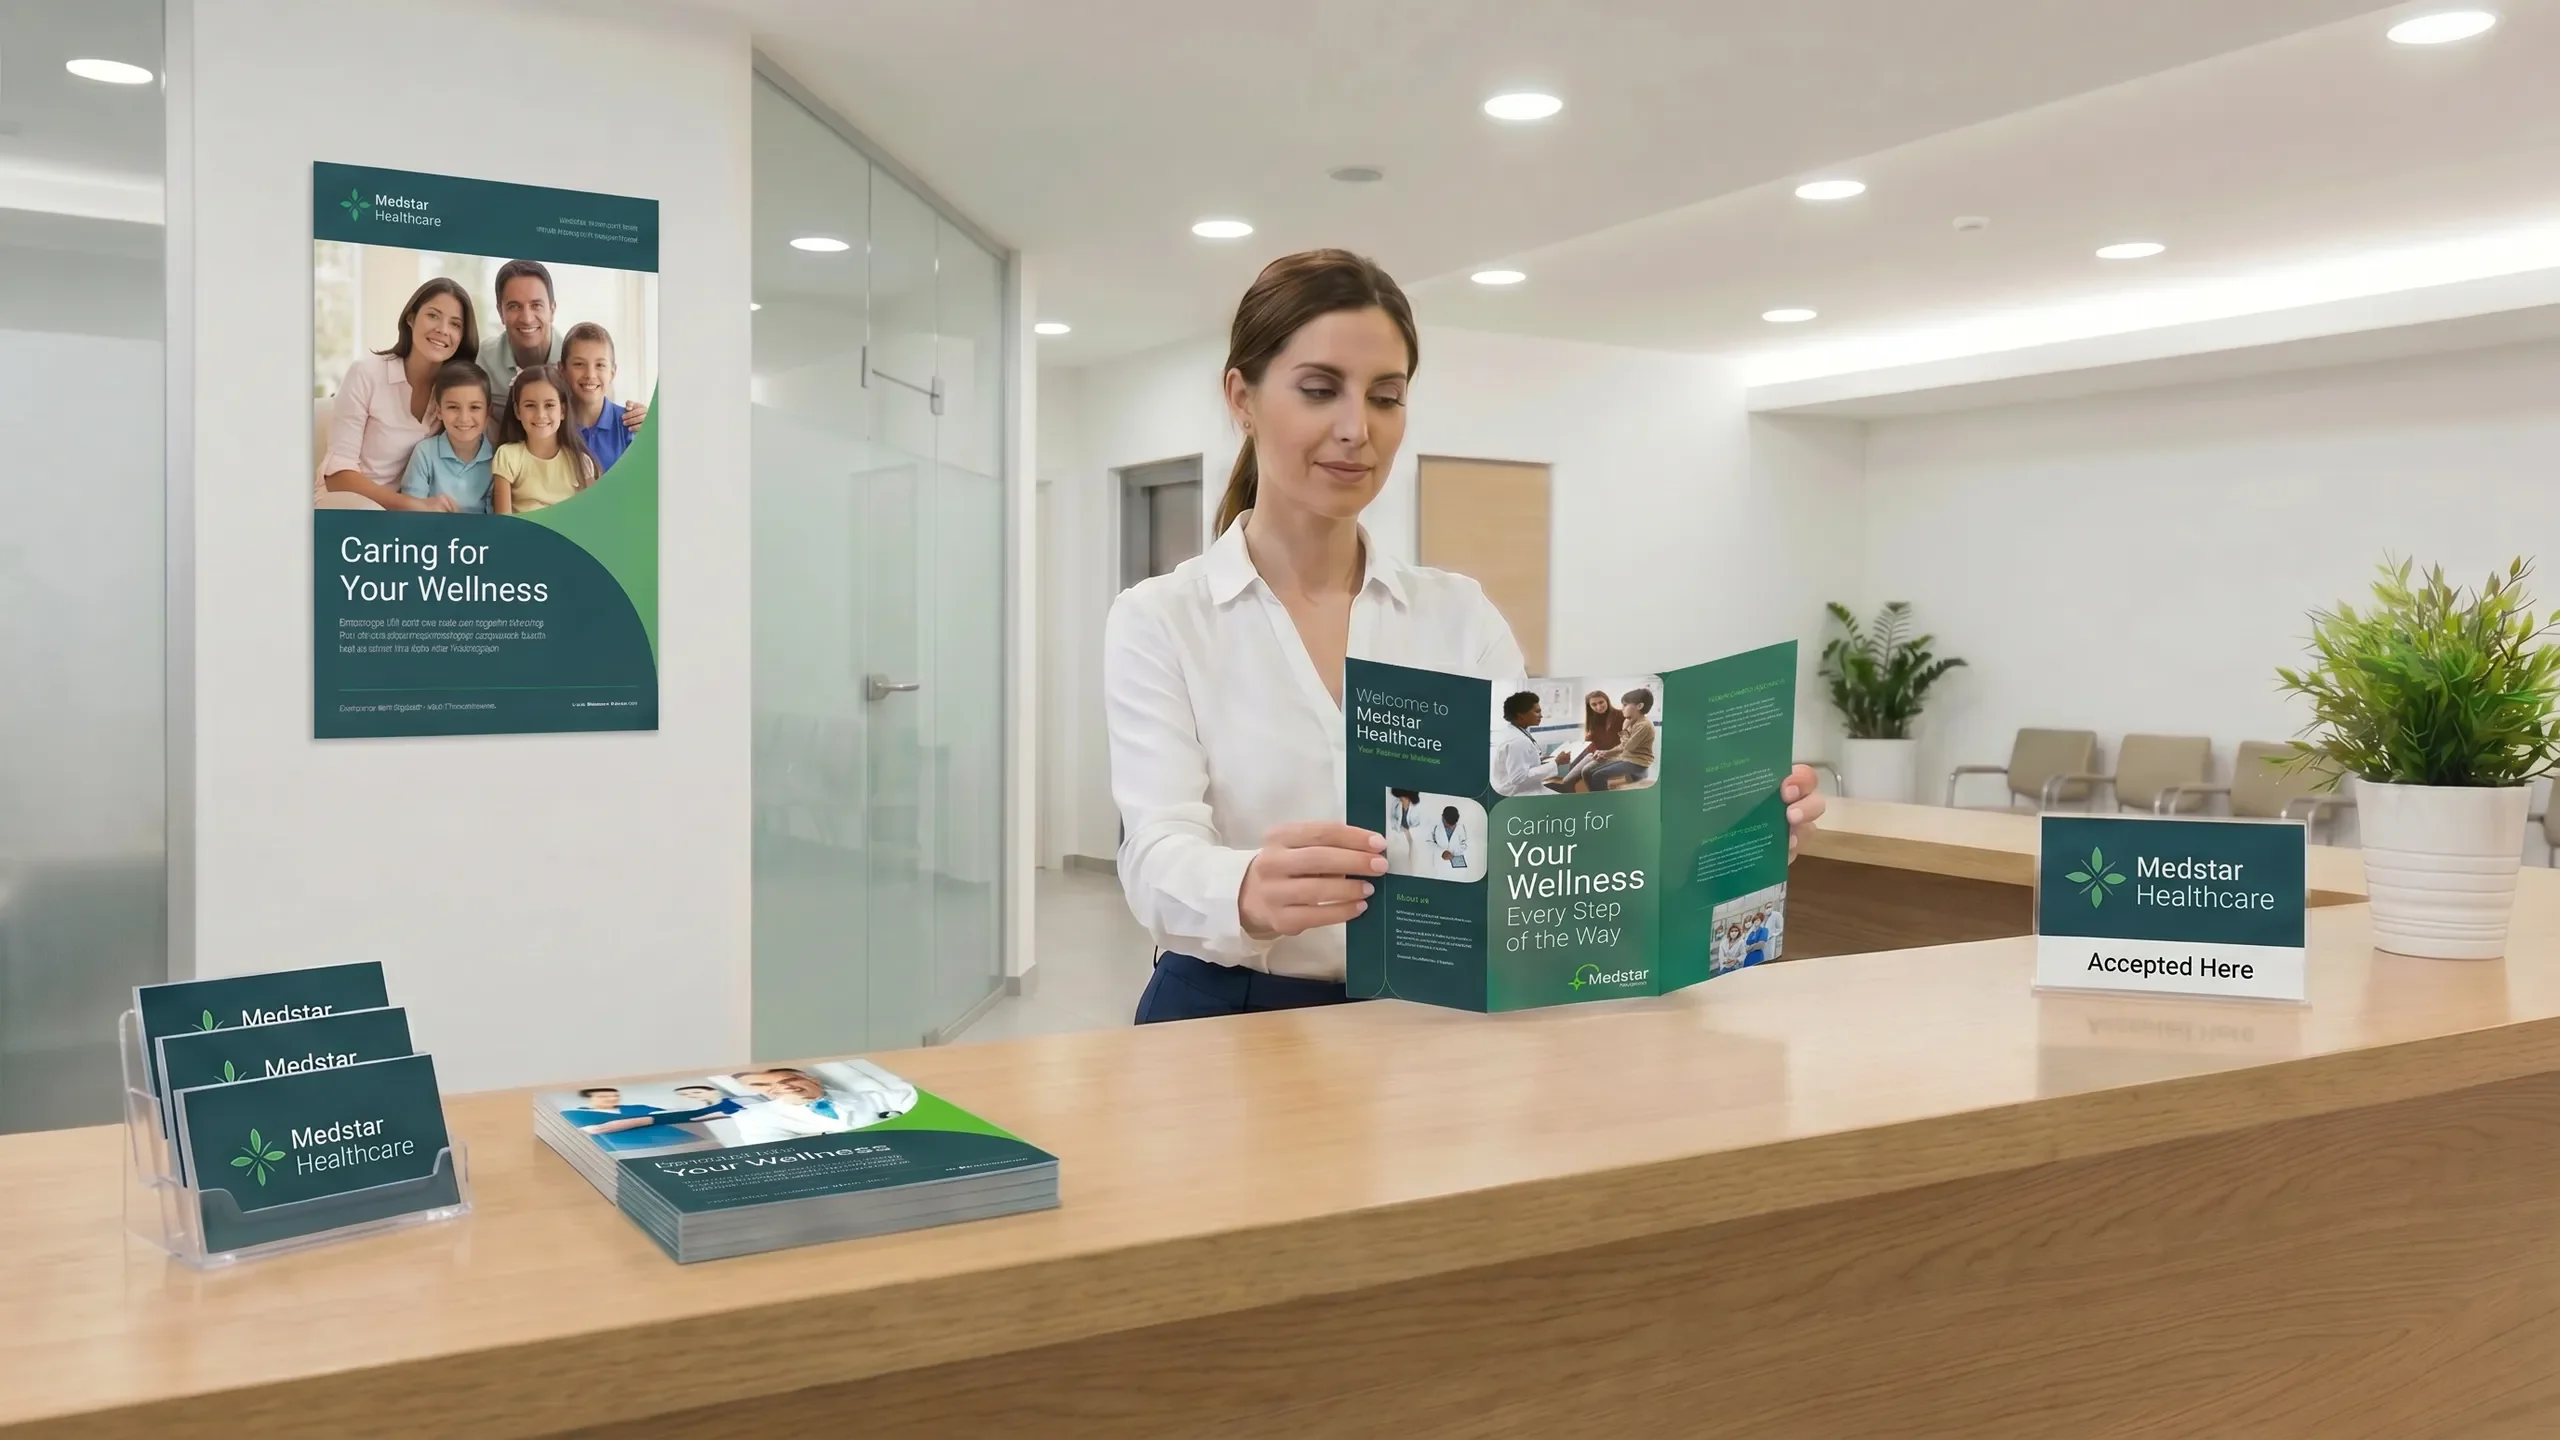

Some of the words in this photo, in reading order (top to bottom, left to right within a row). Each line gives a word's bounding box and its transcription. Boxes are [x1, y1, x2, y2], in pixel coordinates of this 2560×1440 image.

[375, 194, 429, 210] Medstar
[375, 209, 442, 227] Healthcare
[340, 536, 438, 571] Caring
[448, 537, 489, 565] for
[340, 574, 409, 601] Your
[418, 575, 548, 602] Wellness
[1356, 687, 1429, 713] Welcome
[1433, 701, 1449, 716] to
[1357, 706, 1422, 729] Medstar
[1357, 724, 1442, 751] Healthcare
[1507, 815, 1576, 838] Caring
[1584, 811, 1614, 831] for
[1506, 841, 1577, 868] Your
[2136, 857, 2244, 881] Medstar
[1507, 869, 1645, 900] Wellness
[2136, 884, 2275, 910] Healthcare
[1507, 906, 1567, 927] Every
[1573, 901, 1621, 922] Step
[1506, 931, 1529, 952] of
[1535, 929, 1569, 949] the
[1576, 926, 1621, 947] Way
[1589, 969, 1650, 985] Medstar
[2087, 952, 2193, 979] Accepted
[2200, 957, 2254, 980] Here
[242, 1004, 333, 1027] Medstar
[265, 1052, 357, 1078] Medstar
[291, 1119, 384, 1149] Medstar
[296, 1140, 414, 1175] Healthcare
[663, 1162, 739, 1177] Your
[745, 1144, 892, 1167] Wellness
